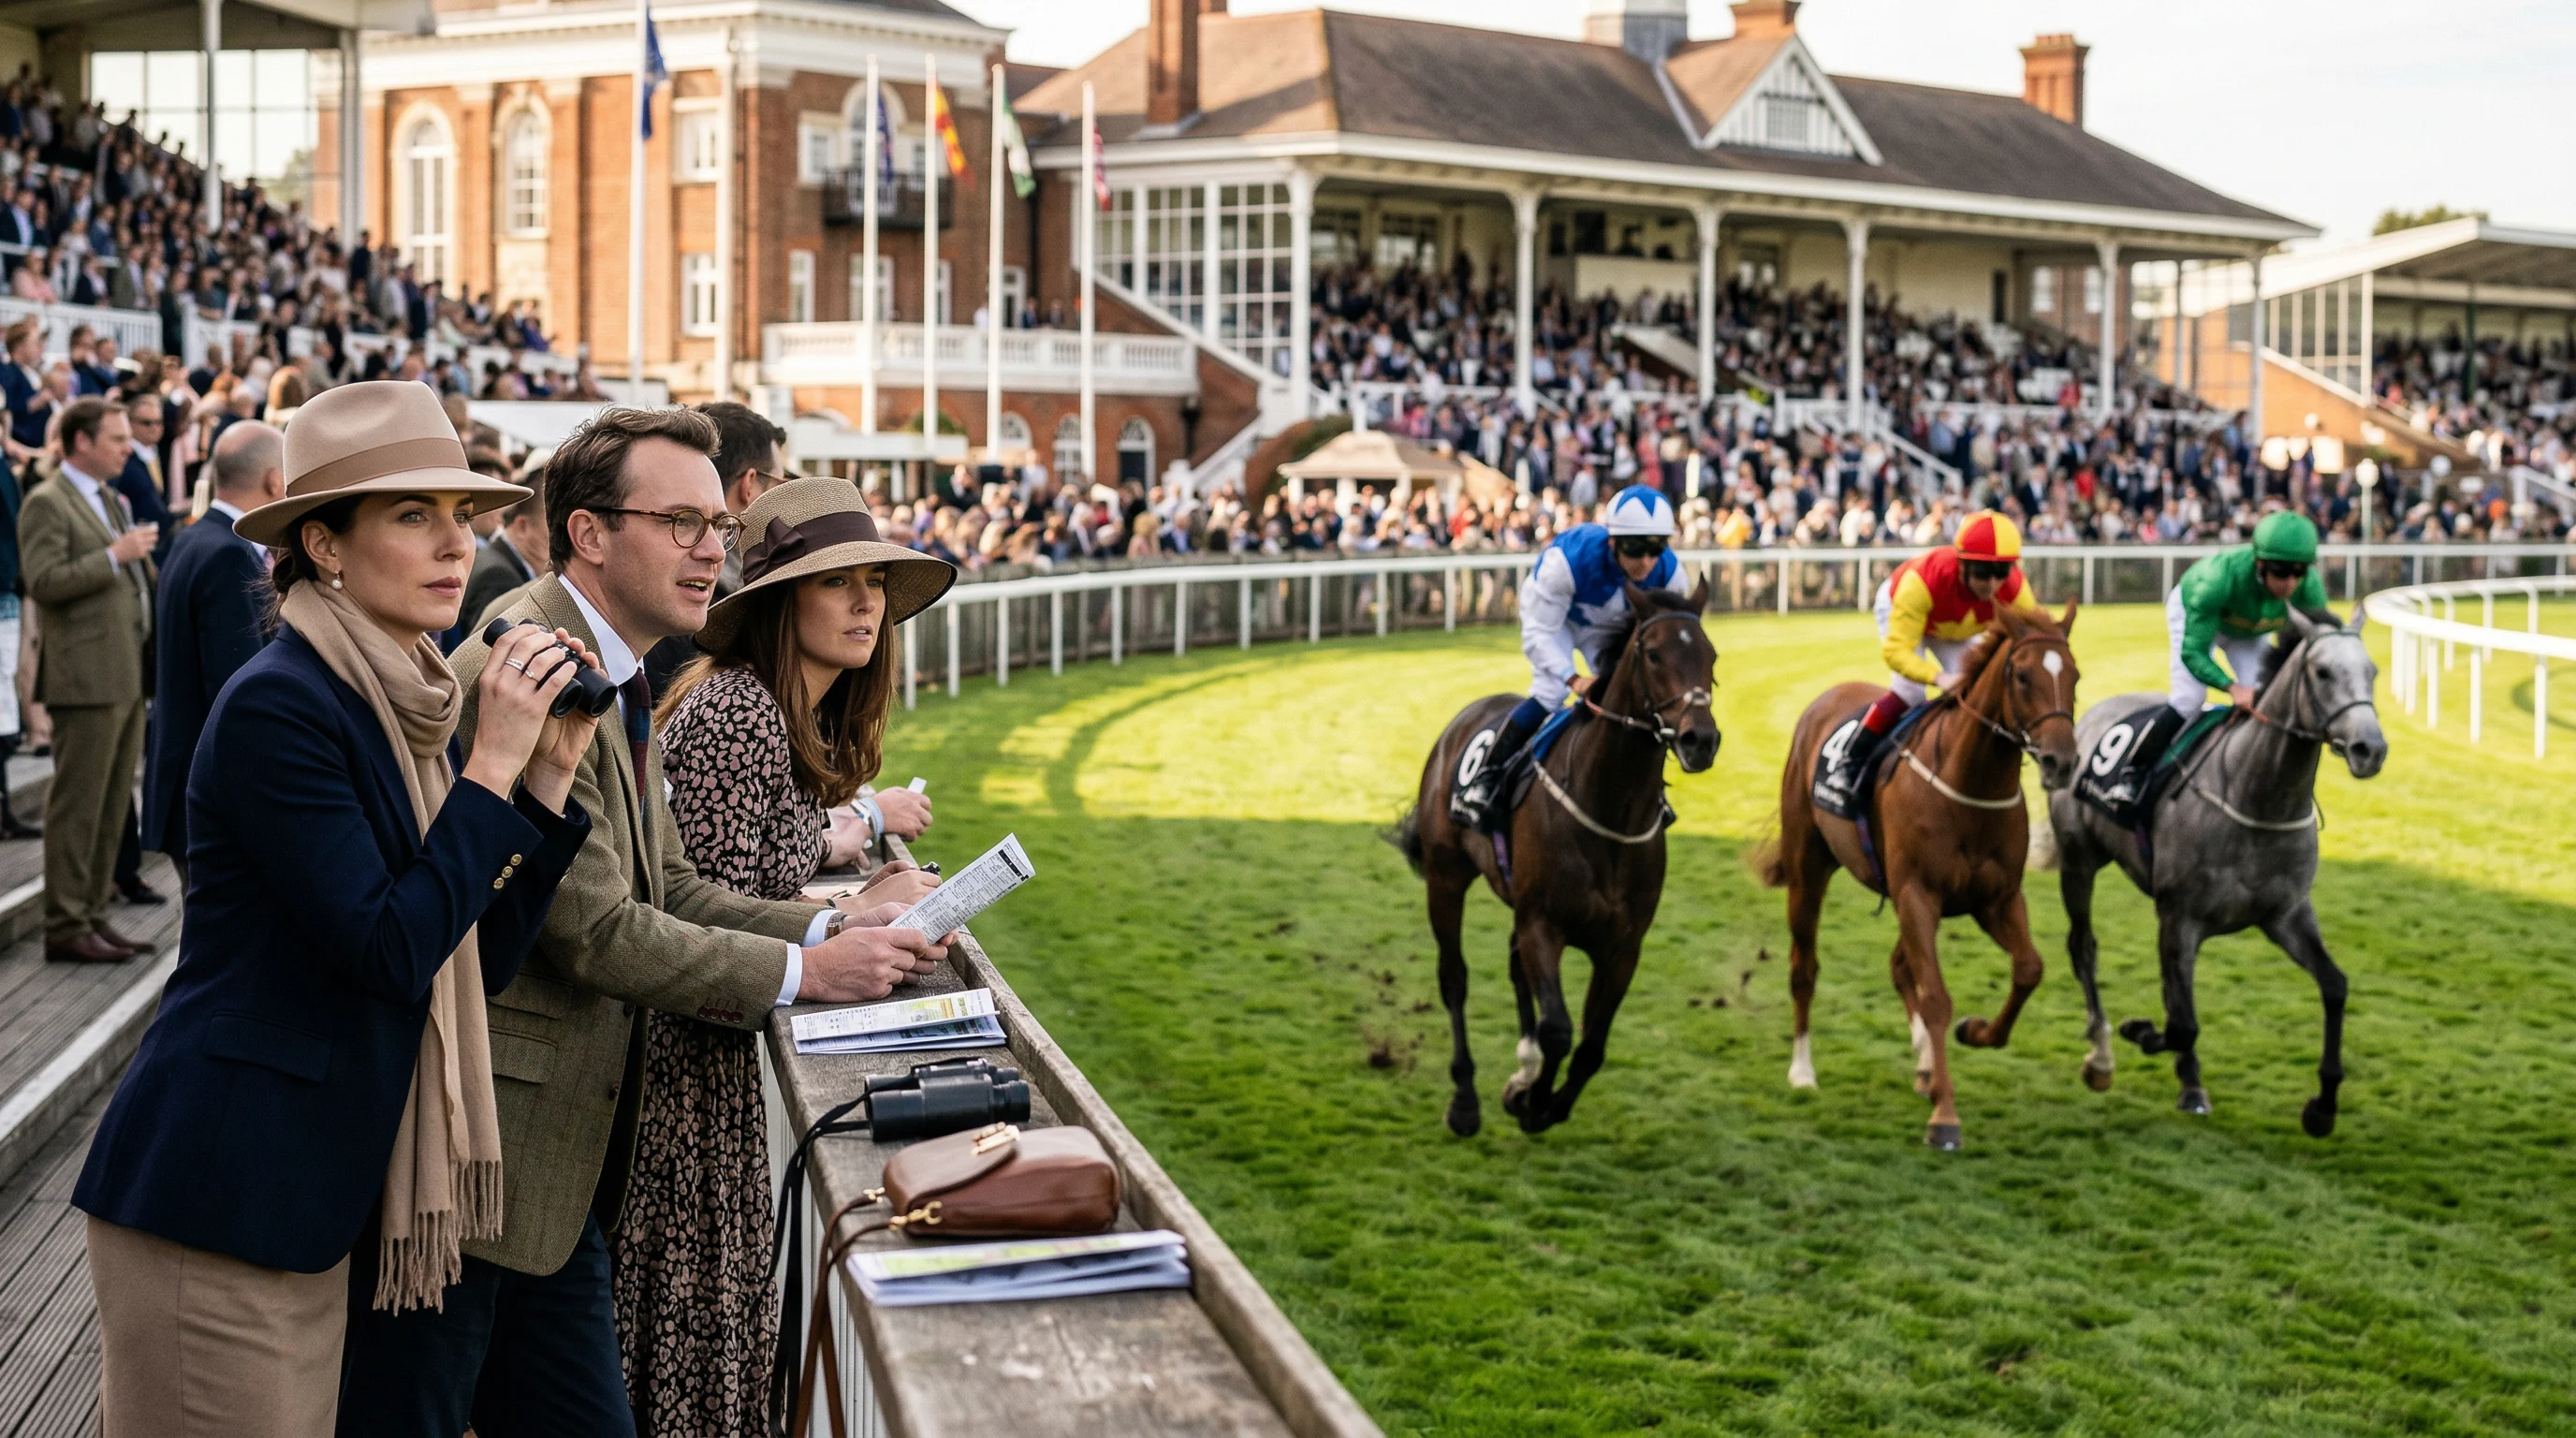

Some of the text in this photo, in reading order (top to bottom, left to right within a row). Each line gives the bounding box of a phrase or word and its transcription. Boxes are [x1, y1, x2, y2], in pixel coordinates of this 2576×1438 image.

[1457, 728, 1497, 787] 6
[1822, 719, 1859, 773] 4
[2091, 723, 2134, 776] 9
